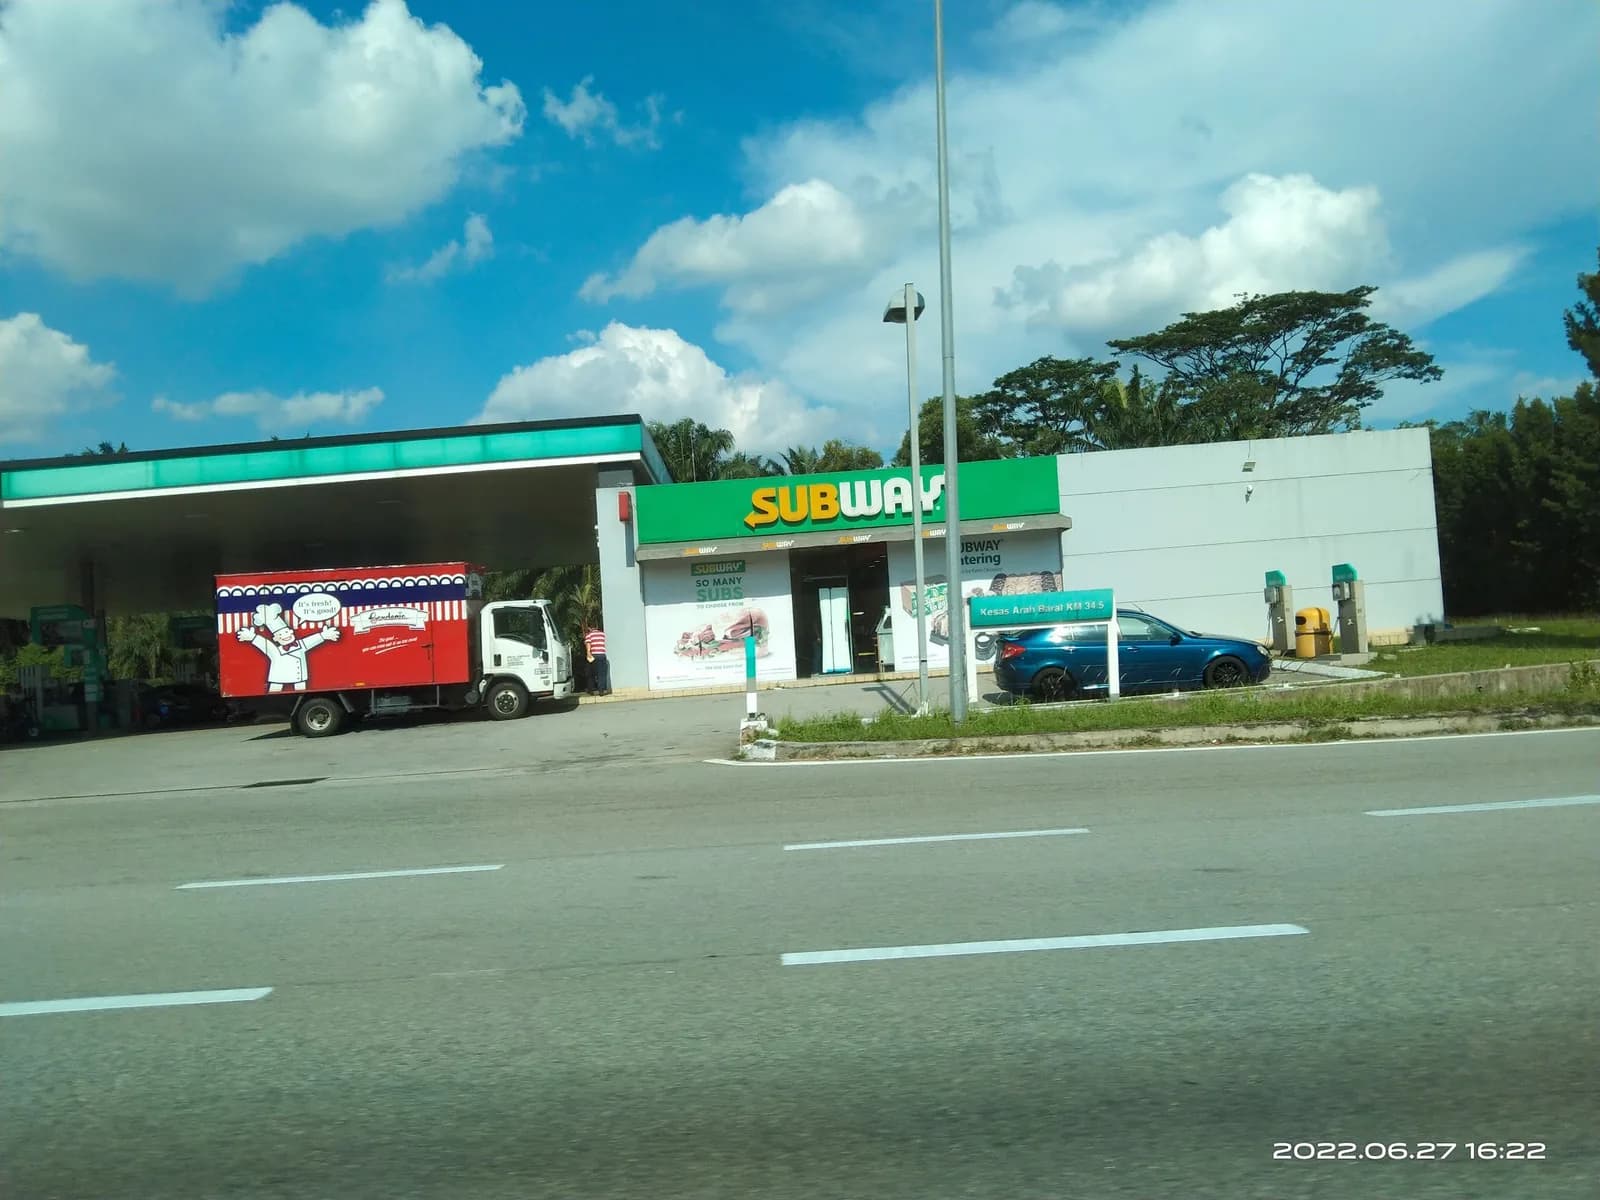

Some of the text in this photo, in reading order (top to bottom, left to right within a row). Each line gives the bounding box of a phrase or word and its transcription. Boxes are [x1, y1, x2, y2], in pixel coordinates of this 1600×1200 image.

[743, 472, 946, 528] SUBWAY
[960, 539, 1001, 553] BWAY
[695, 562, 742, 575] SUBWAY
[696, 576, 743, 588] SO MANY
[697, 586, 744, 602] SUBS
[980, 608, 1009, 617] Kesas
[1013, 605, 1036, 615] Arah
[1038, 603, 1064, 613] Barat
